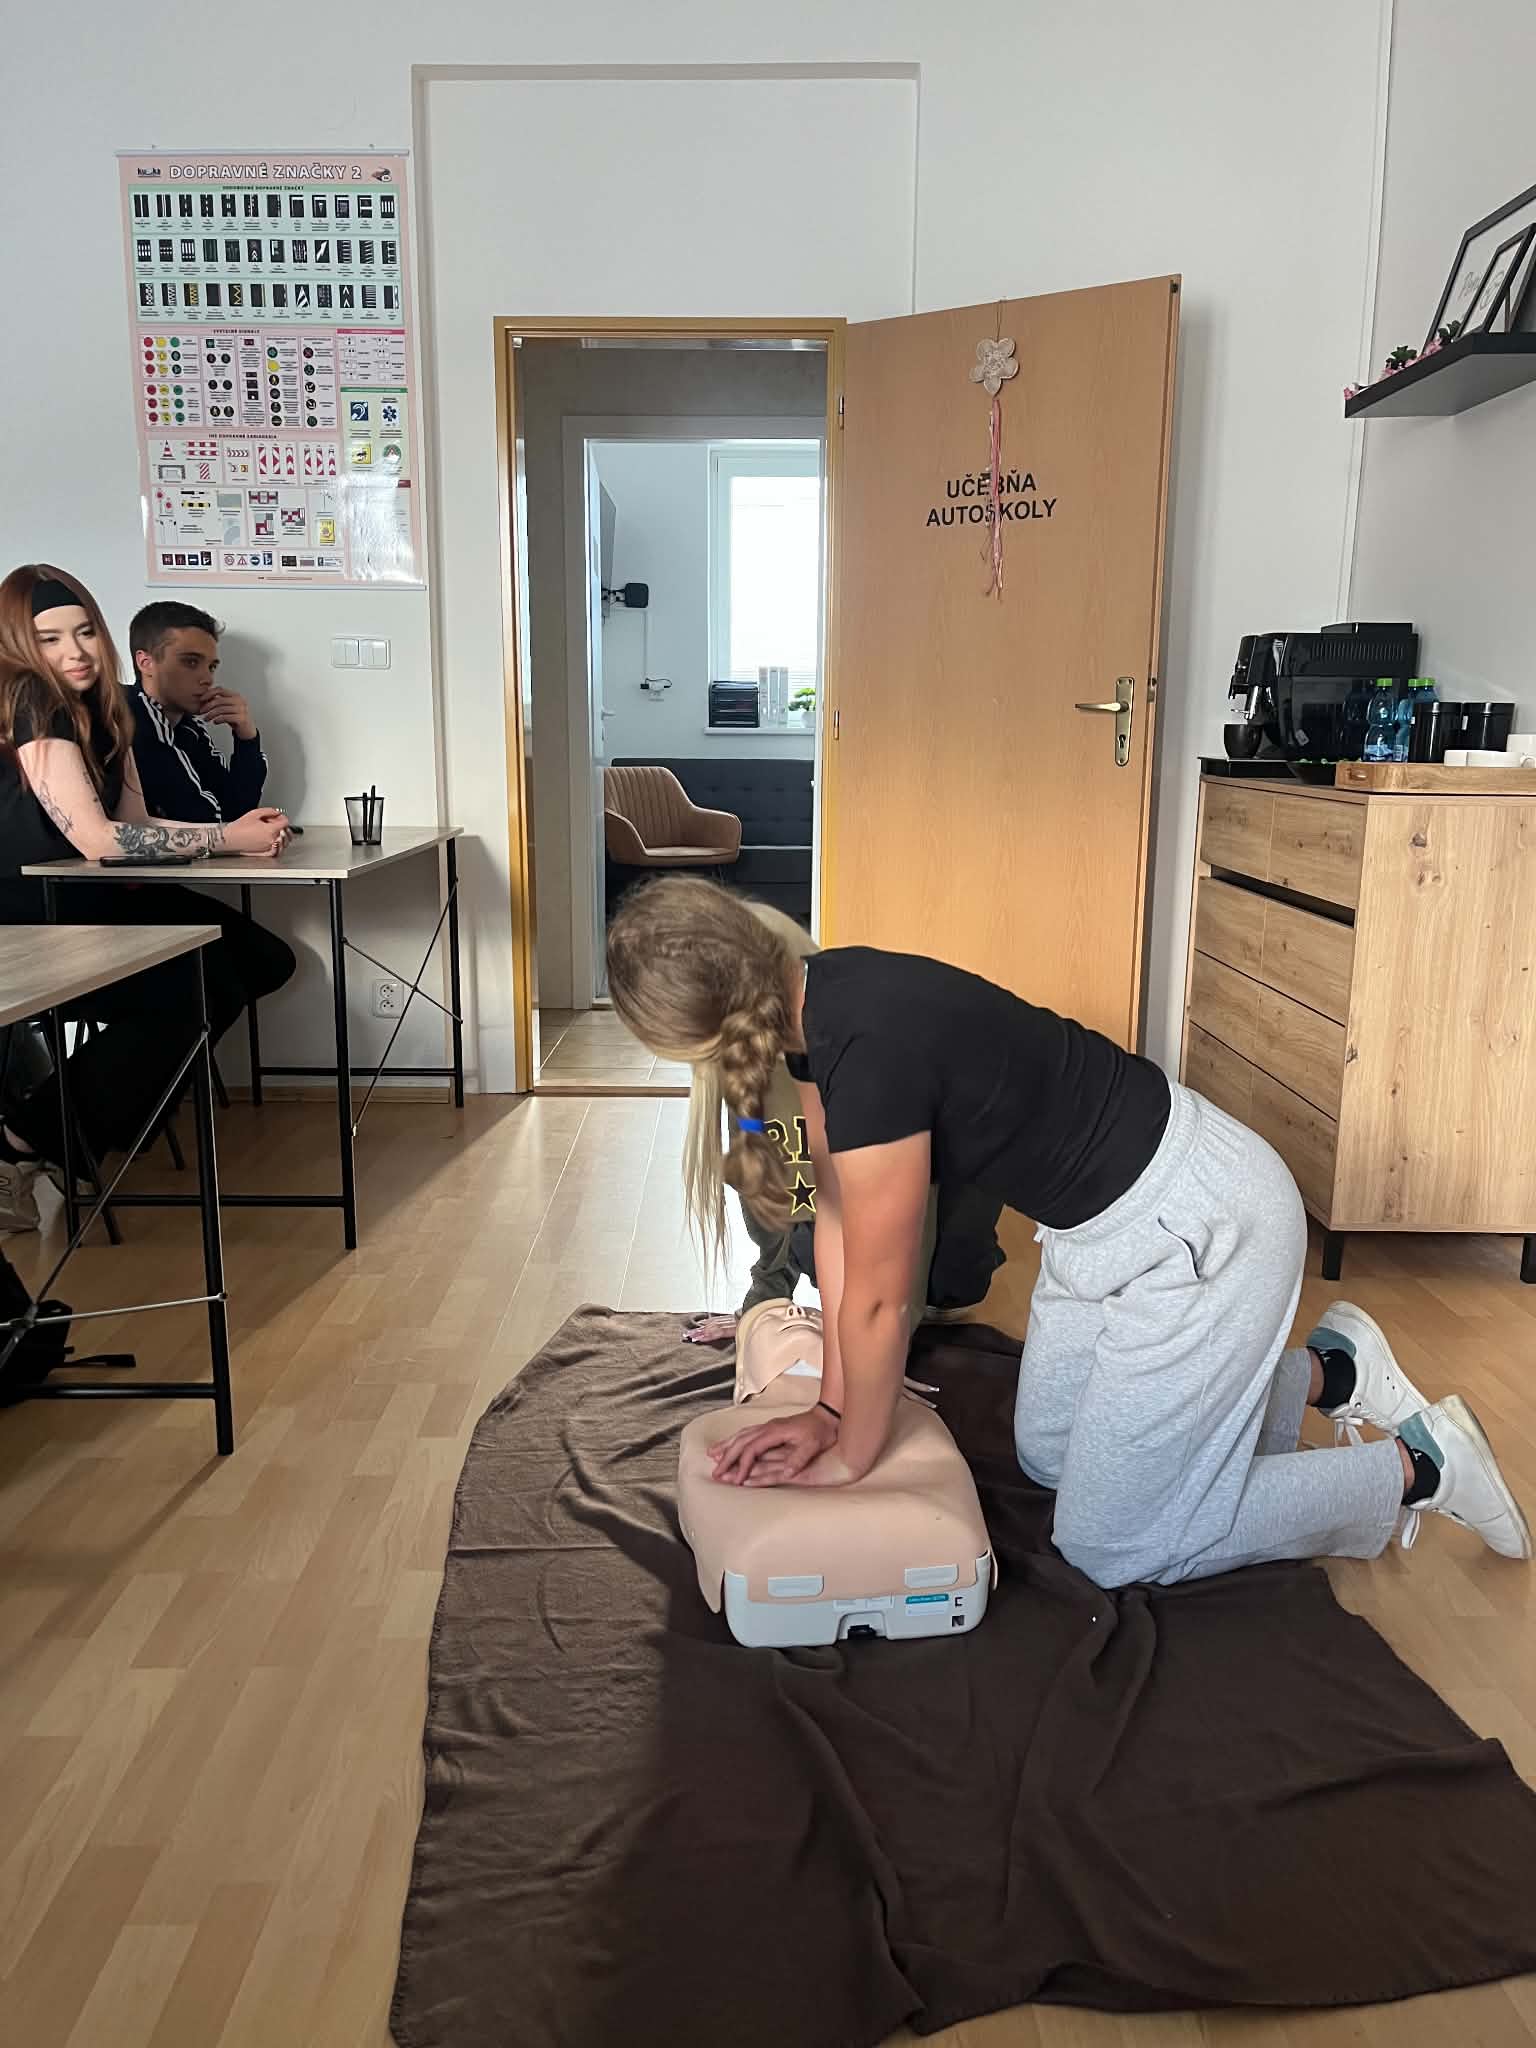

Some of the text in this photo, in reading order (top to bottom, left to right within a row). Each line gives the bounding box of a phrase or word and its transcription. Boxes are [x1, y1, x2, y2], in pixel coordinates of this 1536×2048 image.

[170, 162, 362, 180] DOPRAVNÉ ZNAČKY 2
